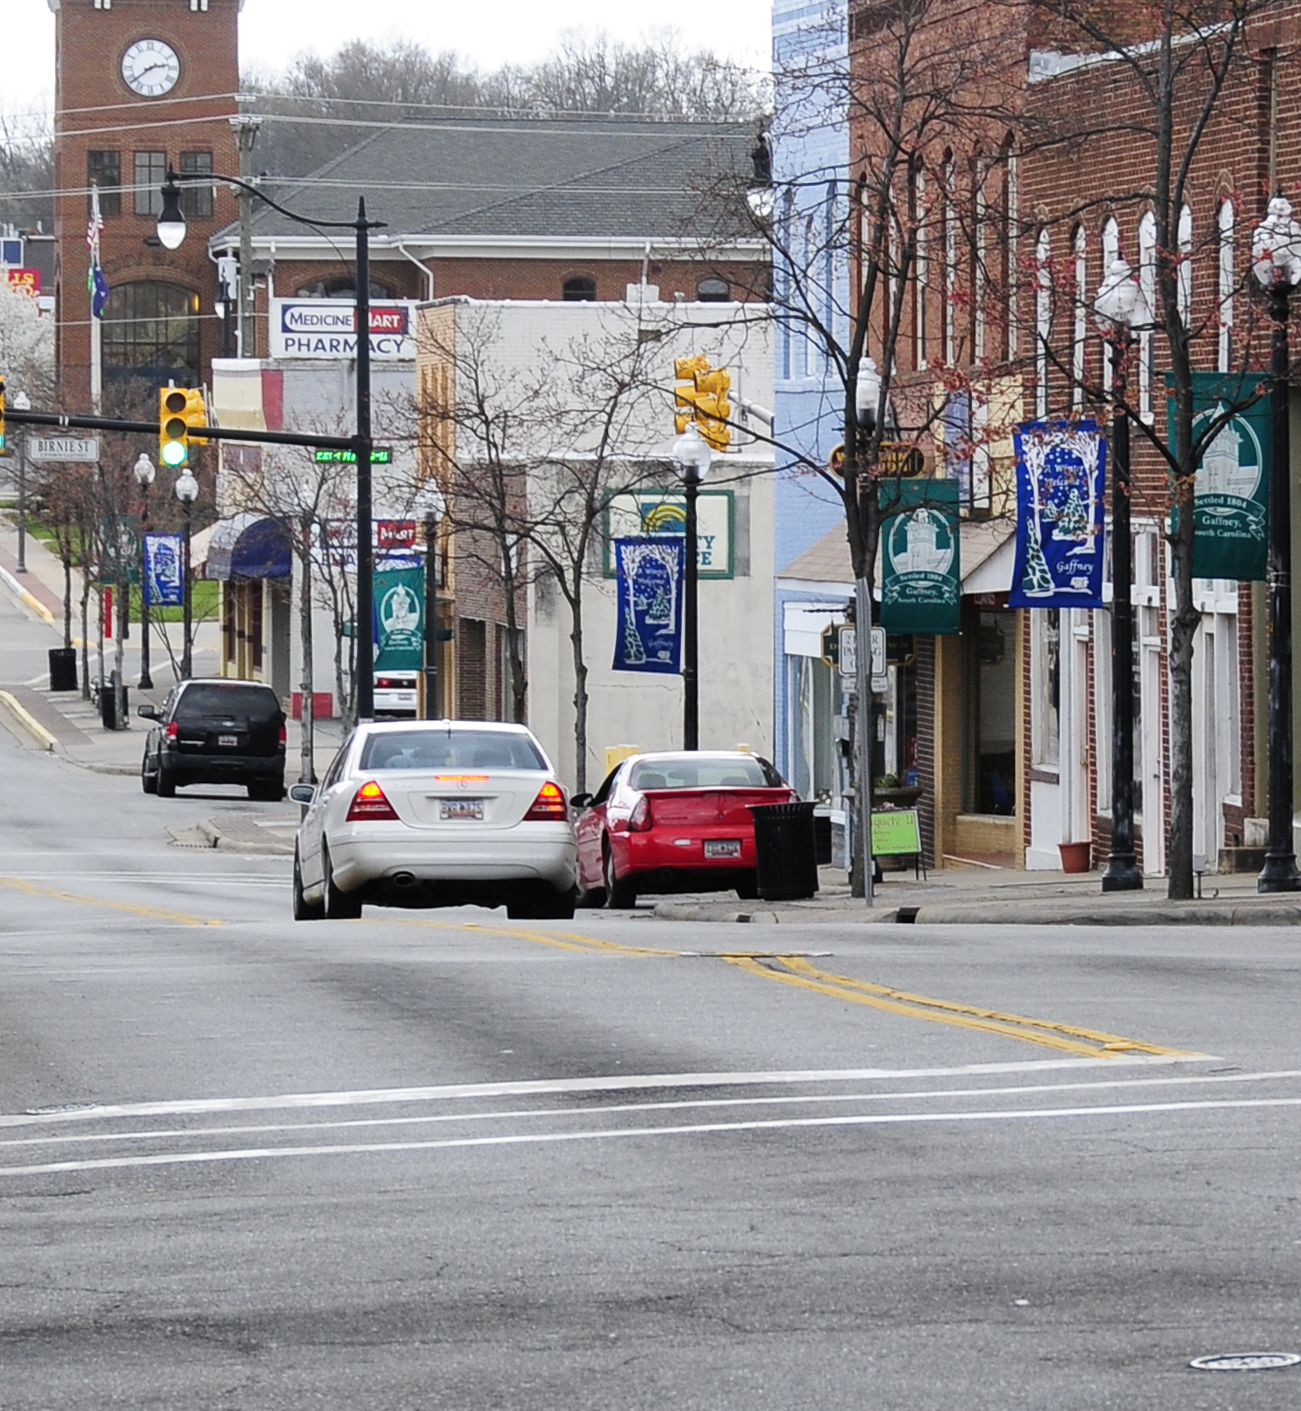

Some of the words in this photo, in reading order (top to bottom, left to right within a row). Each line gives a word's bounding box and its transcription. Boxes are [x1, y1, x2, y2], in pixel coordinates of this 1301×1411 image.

[367, 313, 401, 329] ART
[1194, 528, 1216, 538] outh
[1056, 558, 1094, 575] Gaffney
